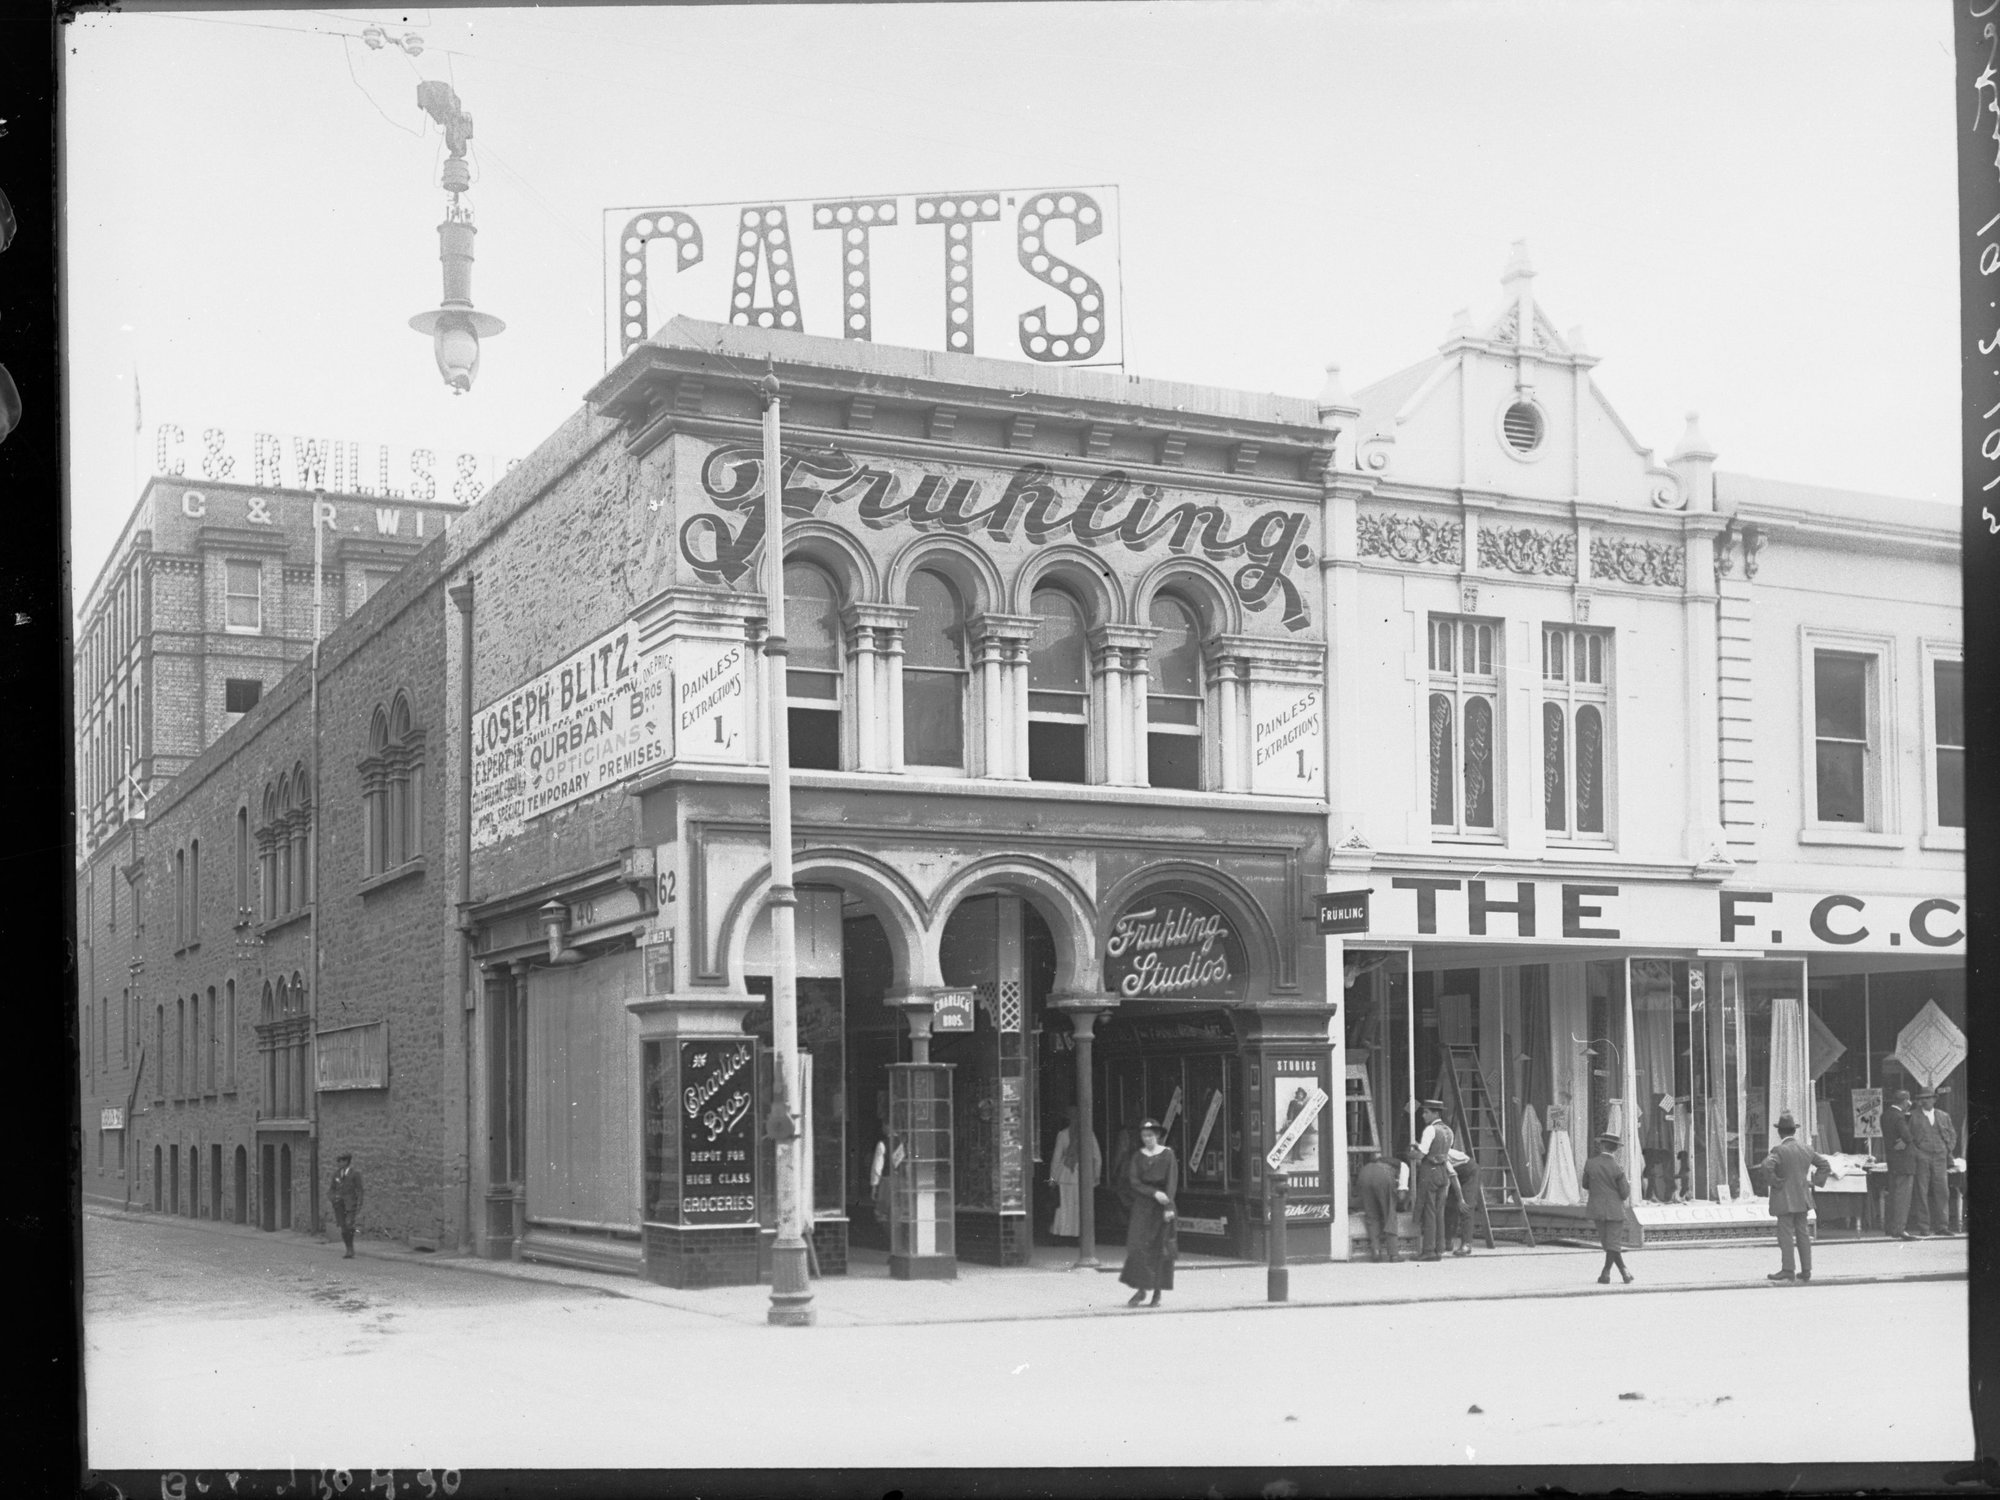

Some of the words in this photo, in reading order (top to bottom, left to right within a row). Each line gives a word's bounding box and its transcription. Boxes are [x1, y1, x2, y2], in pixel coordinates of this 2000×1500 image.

[294, 437, 435, 499] WILLS
[682, 648, 739, 703] PAINLESS
[475, 682, 550, 757] JOSEPH
[682, 673, 741, 730] EXTRACTIONS
[1257, 692, 1315, 742] PAINLESS
[531, 706, 613, 770] QURBAN
[1257, 713, 1319, 766] EXTRACTIONS
[527, 771, 590, 812] TEMPORARY
[658, 870, 676, 904] 62
[1392, 877, 1620, 939] THE
[1277, 1060, 1317, 1072] STUDIOS
[686, 1174, 712, 1185] HIGH
[718, 1172, 751, 1184] CLASS
[690, 1150, 722, 1162] DEPOT
[727, 1150, 745, 1161] FOR
[683, 1195, 754, 1212] GROCERIES
